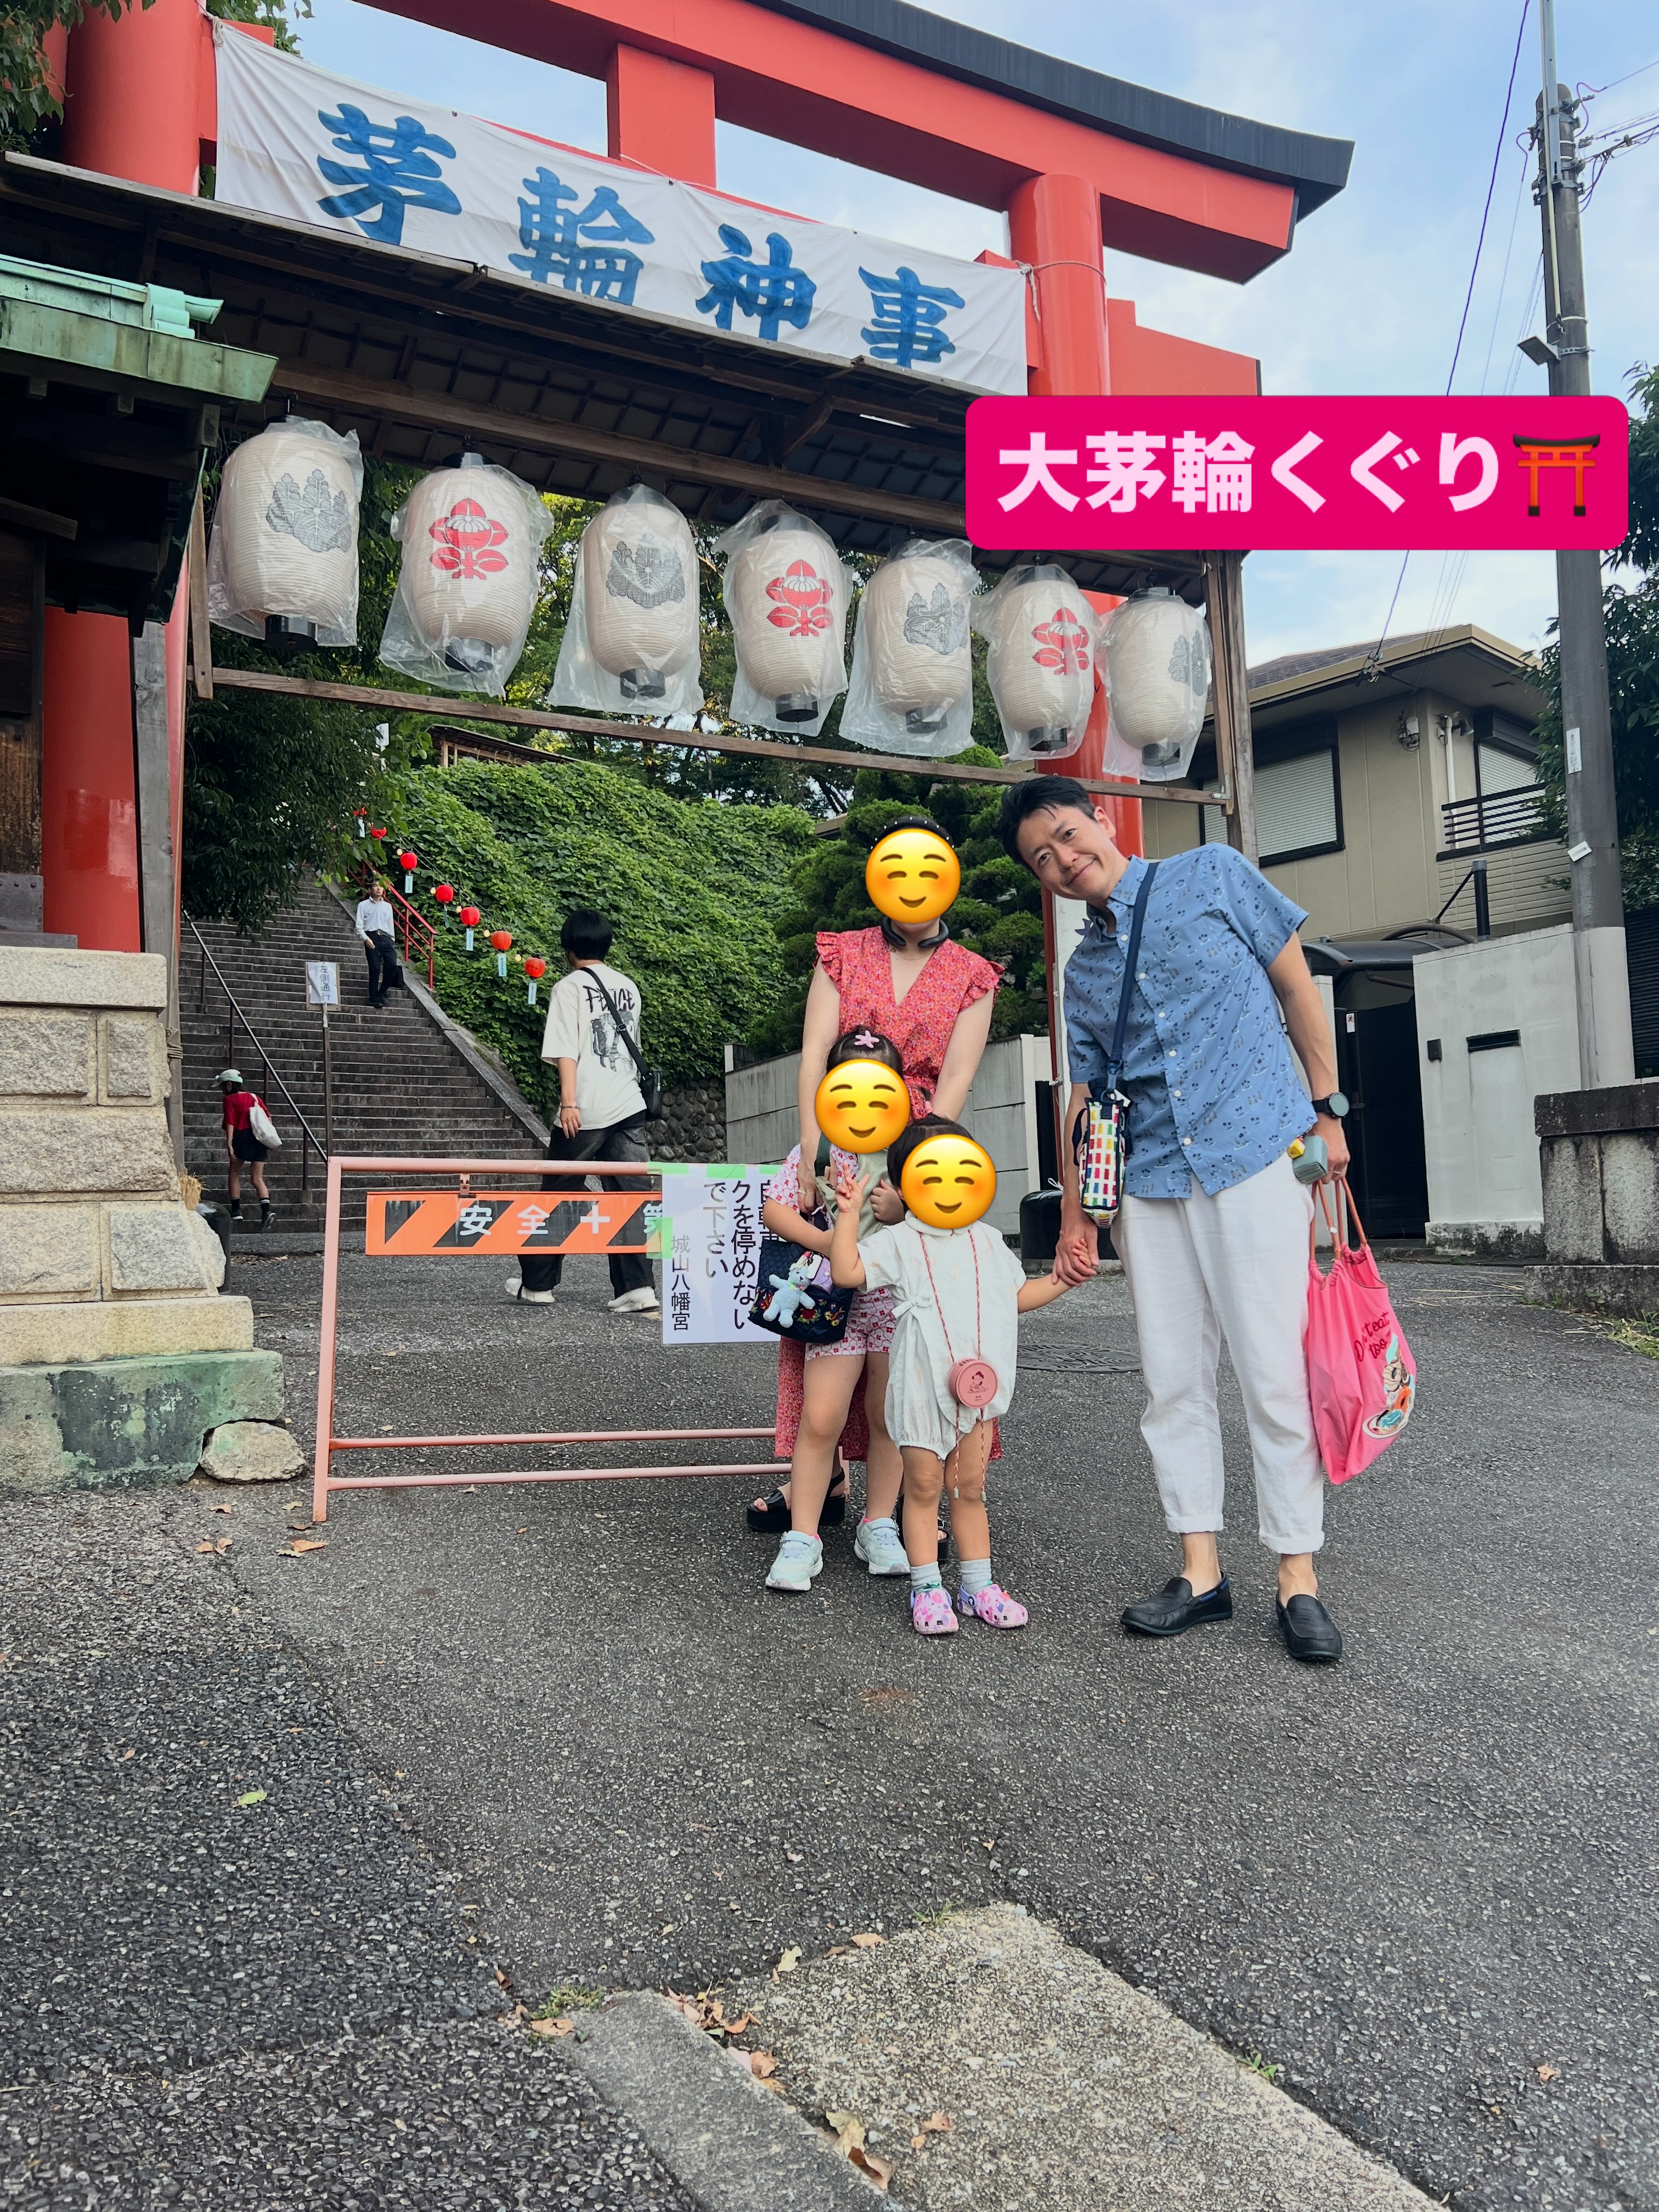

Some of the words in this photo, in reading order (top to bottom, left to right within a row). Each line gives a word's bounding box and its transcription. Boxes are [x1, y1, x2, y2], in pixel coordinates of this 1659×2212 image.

[317, 103, 965, 369] 茅輪神事
[319, 966, 331, 1001] 左側通行
[703, 1182, 729, 1279] で下さい
[671, 1235, 691, 1331] 城山八幡宮
[1373, 1312, 1389, 1331] eat
